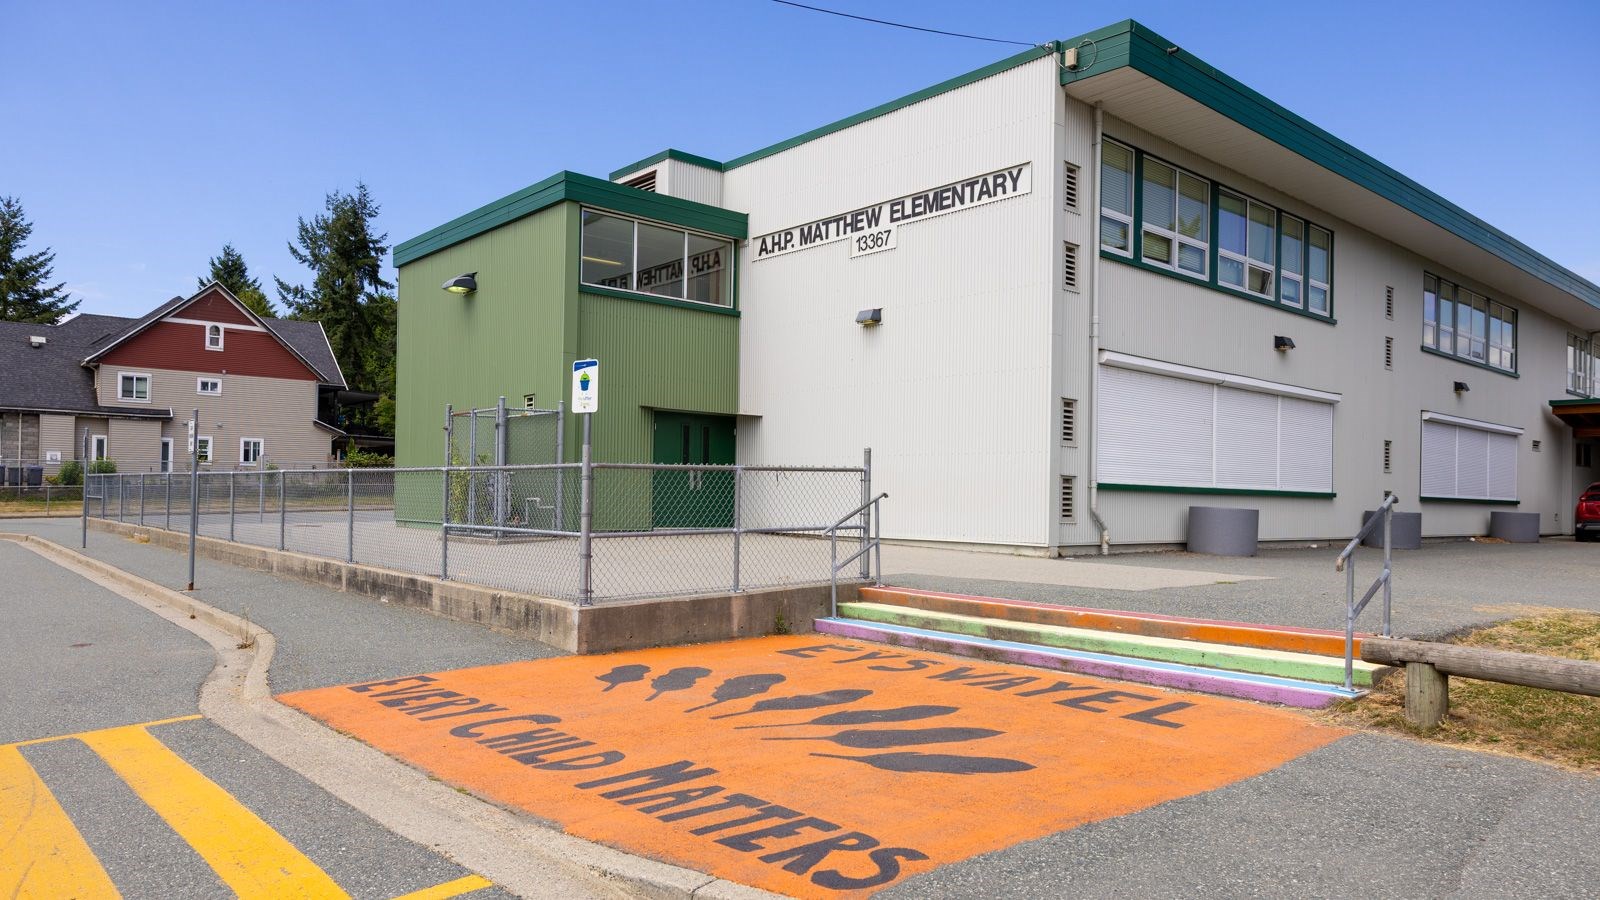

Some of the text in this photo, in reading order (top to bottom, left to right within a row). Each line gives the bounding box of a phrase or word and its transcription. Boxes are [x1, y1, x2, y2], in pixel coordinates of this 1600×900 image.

[758, 167, 1023, 257] A.H.P. MATTHEW ELEMENTARY
[855, 229, 892, 252] 13367
[347, 675, 930, 890] EVERY CHILD MATTERS
